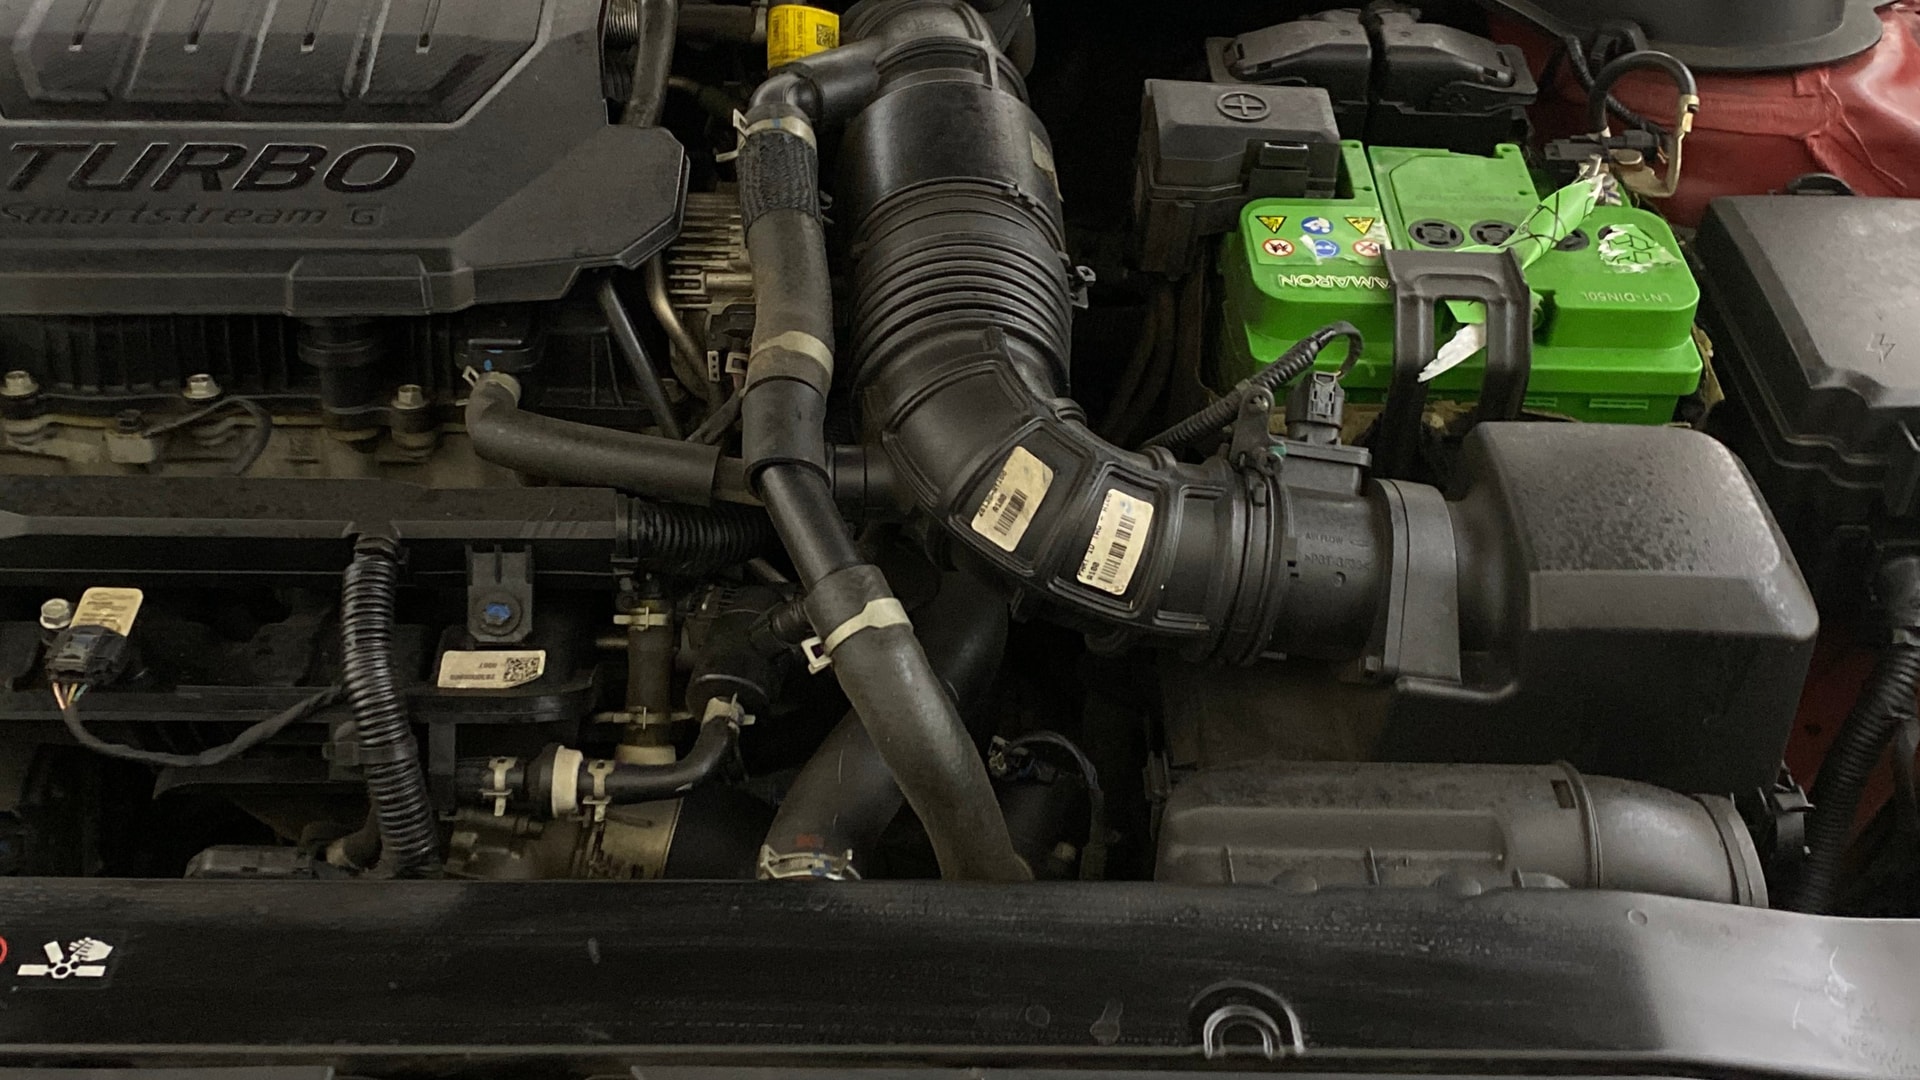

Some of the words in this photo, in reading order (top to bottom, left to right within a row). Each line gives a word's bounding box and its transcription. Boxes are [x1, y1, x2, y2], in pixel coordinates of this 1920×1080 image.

[6, 142, 416, 193] TURBO
[1277, 273, 1391, 290] AMARON
[1579, 290, 1673, 304] LN1-DIN50L
